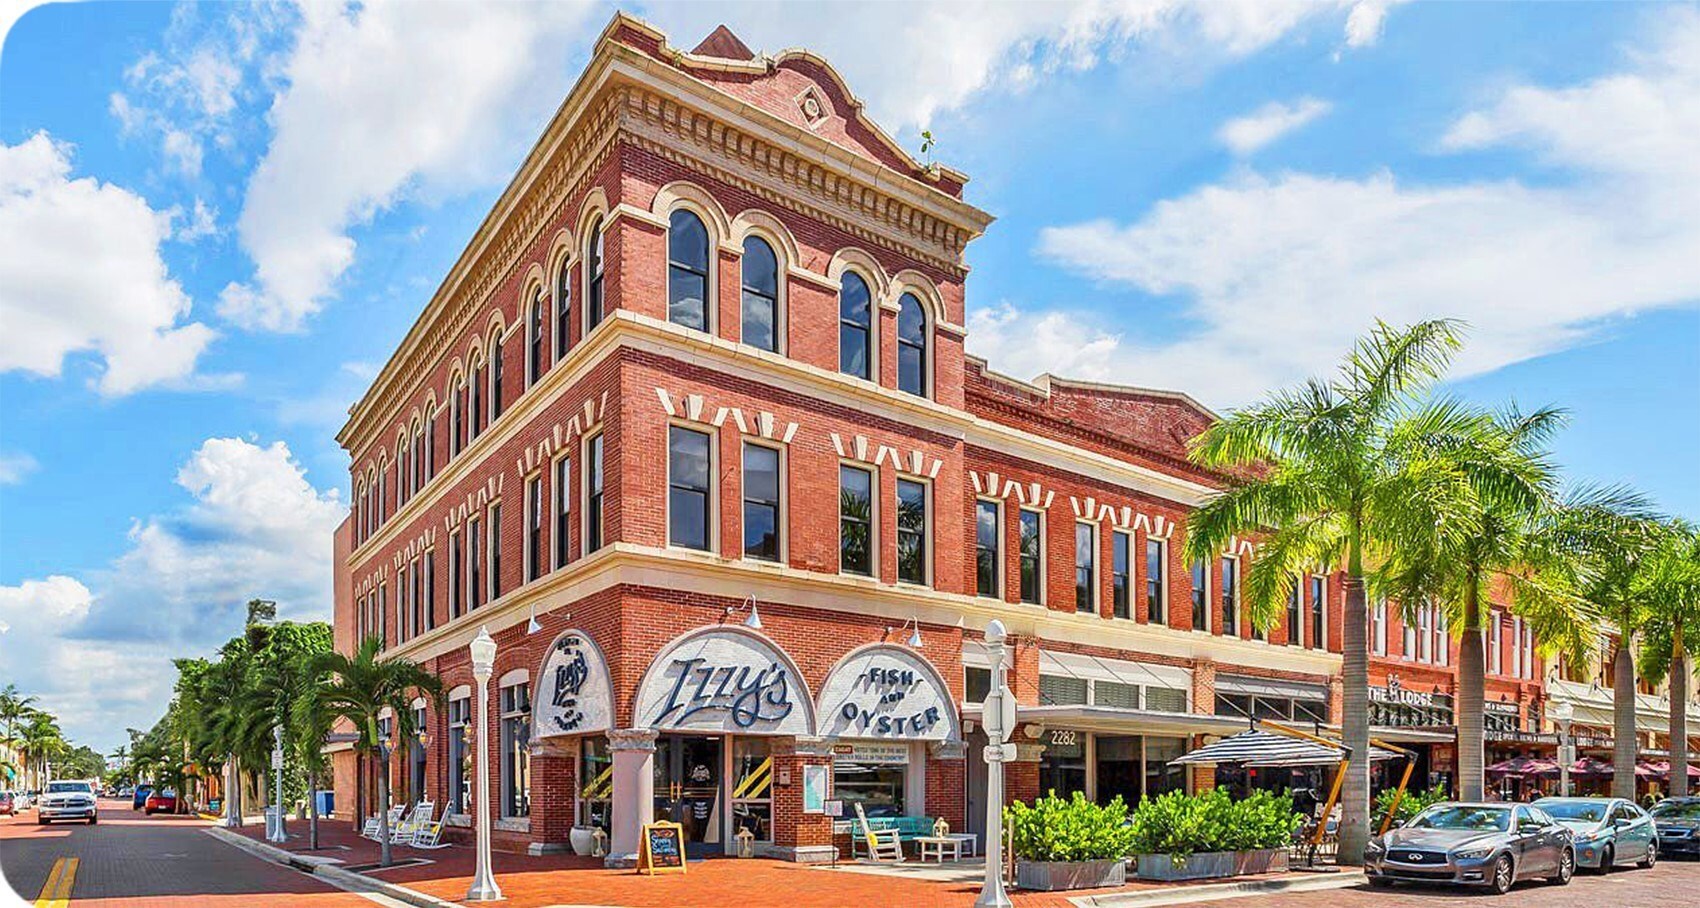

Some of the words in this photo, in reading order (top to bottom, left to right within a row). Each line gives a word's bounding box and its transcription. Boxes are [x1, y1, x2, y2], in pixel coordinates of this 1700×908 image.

[869, 667, 913, 686] FISH
[650, 657, 793, 728] Izzy's
[879, 691, 905, 704] AND
[1368, 687, 1388, 701] THE
[1400, 691, 1433, 706] LODGE
[841, 702, 941, 734] OYSTER
[1050, 730, 1076, 746] 2282
